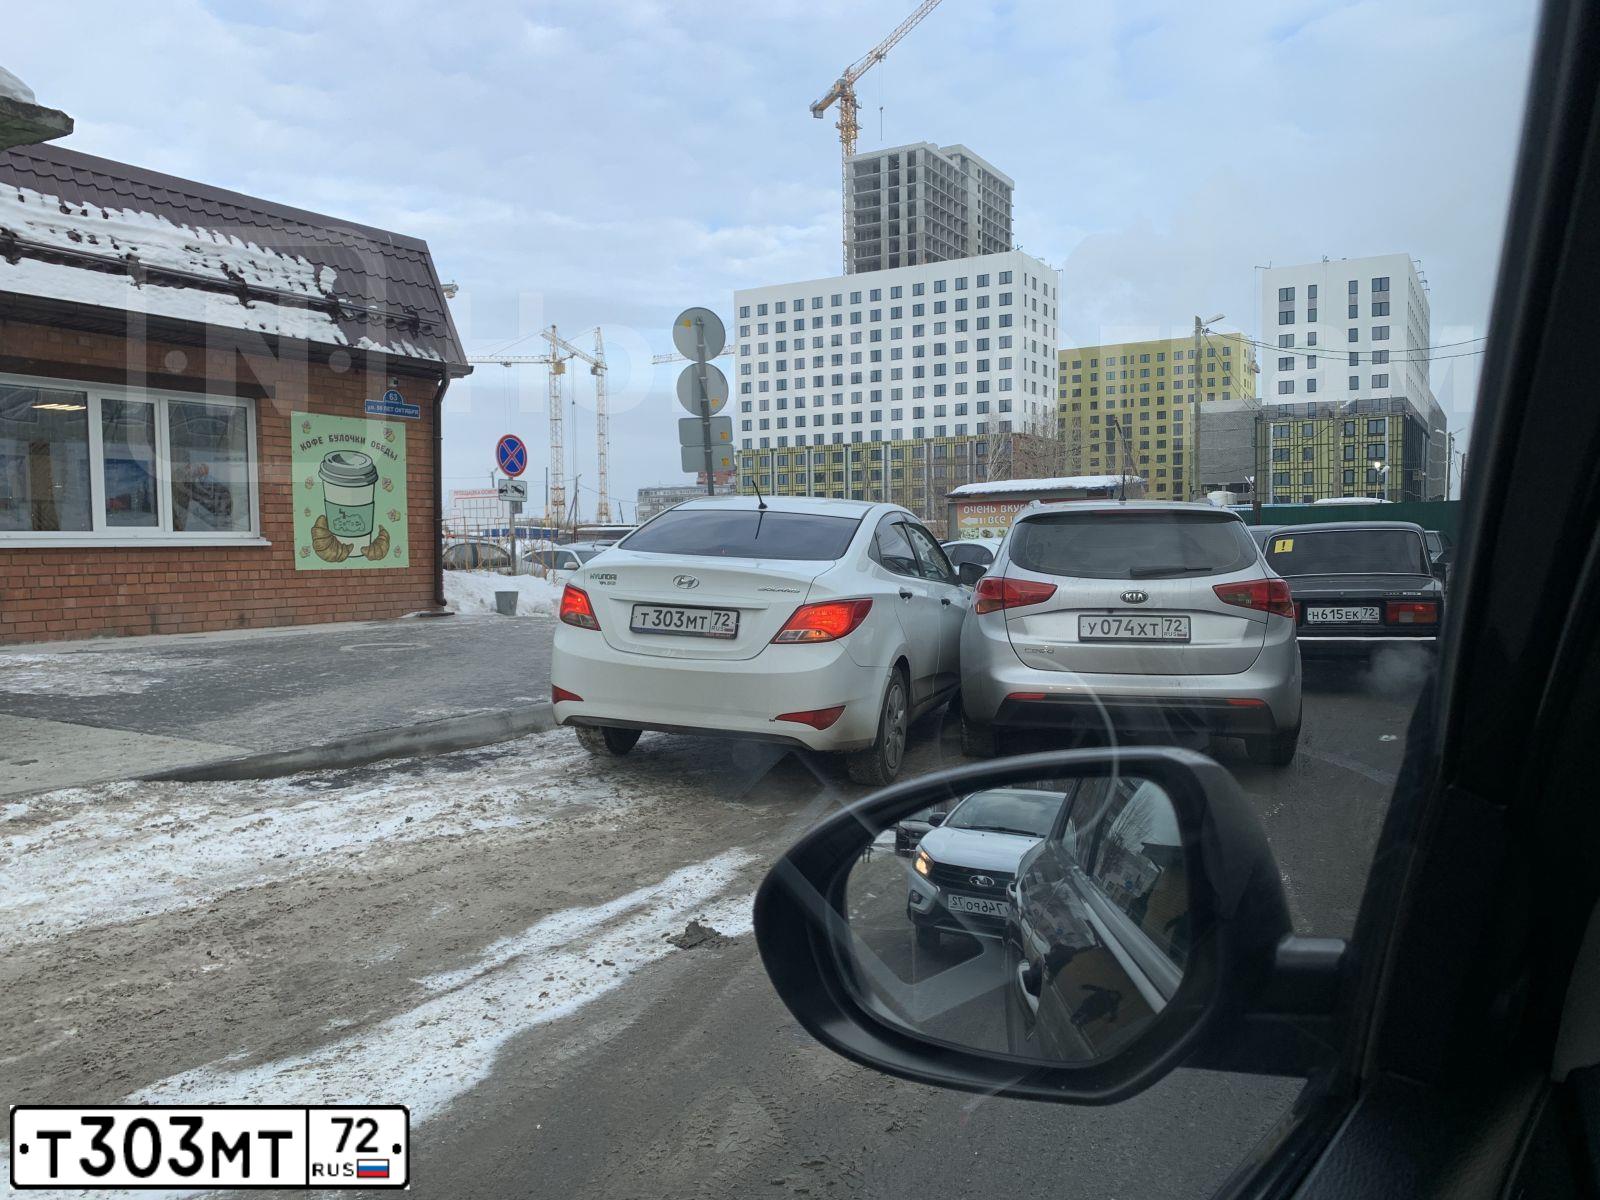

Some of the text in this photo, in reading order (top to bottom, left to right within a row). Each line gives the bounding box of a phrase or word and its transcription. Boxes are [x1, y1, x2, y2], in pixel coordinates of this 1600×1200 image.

[300, 434, 398, 461] КОФЕ БУЛОЧКИ ОБЕДЫ
[1125, 593, 1143, 601] KIA
[640, 609, 731, 630] Т303МТ 72
[1312, 607, 1375, 620] Н615ЕК 72
[1087, 618, 1182, 636] У074ХТ 72
